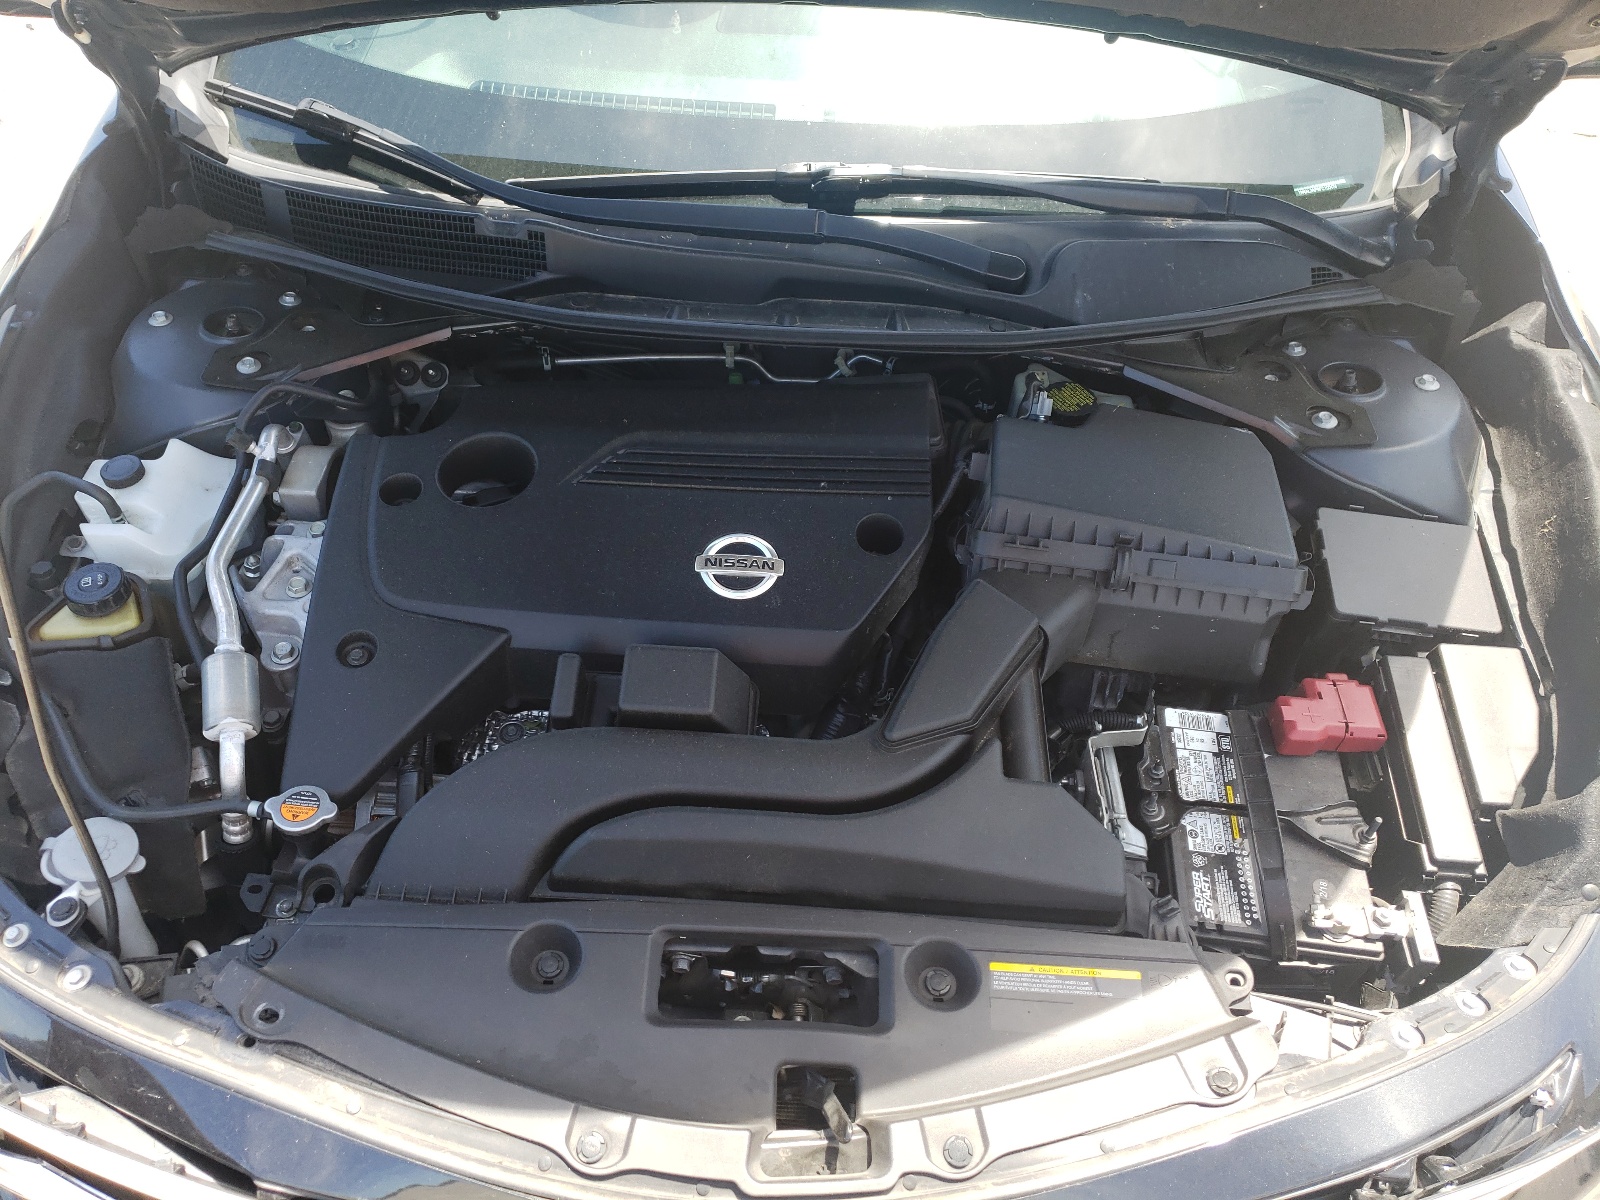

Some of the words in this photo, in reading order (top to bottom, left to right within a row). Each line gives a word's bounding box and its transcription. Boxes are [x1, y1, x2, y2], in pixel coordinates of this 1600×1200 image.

[704, 557, 775, 571] NISSAN
[1191, 870, 1205, 913] SUPER
[1200, 871, 1215, 921] START
[1318, 881, 1328, 899] 2/18
